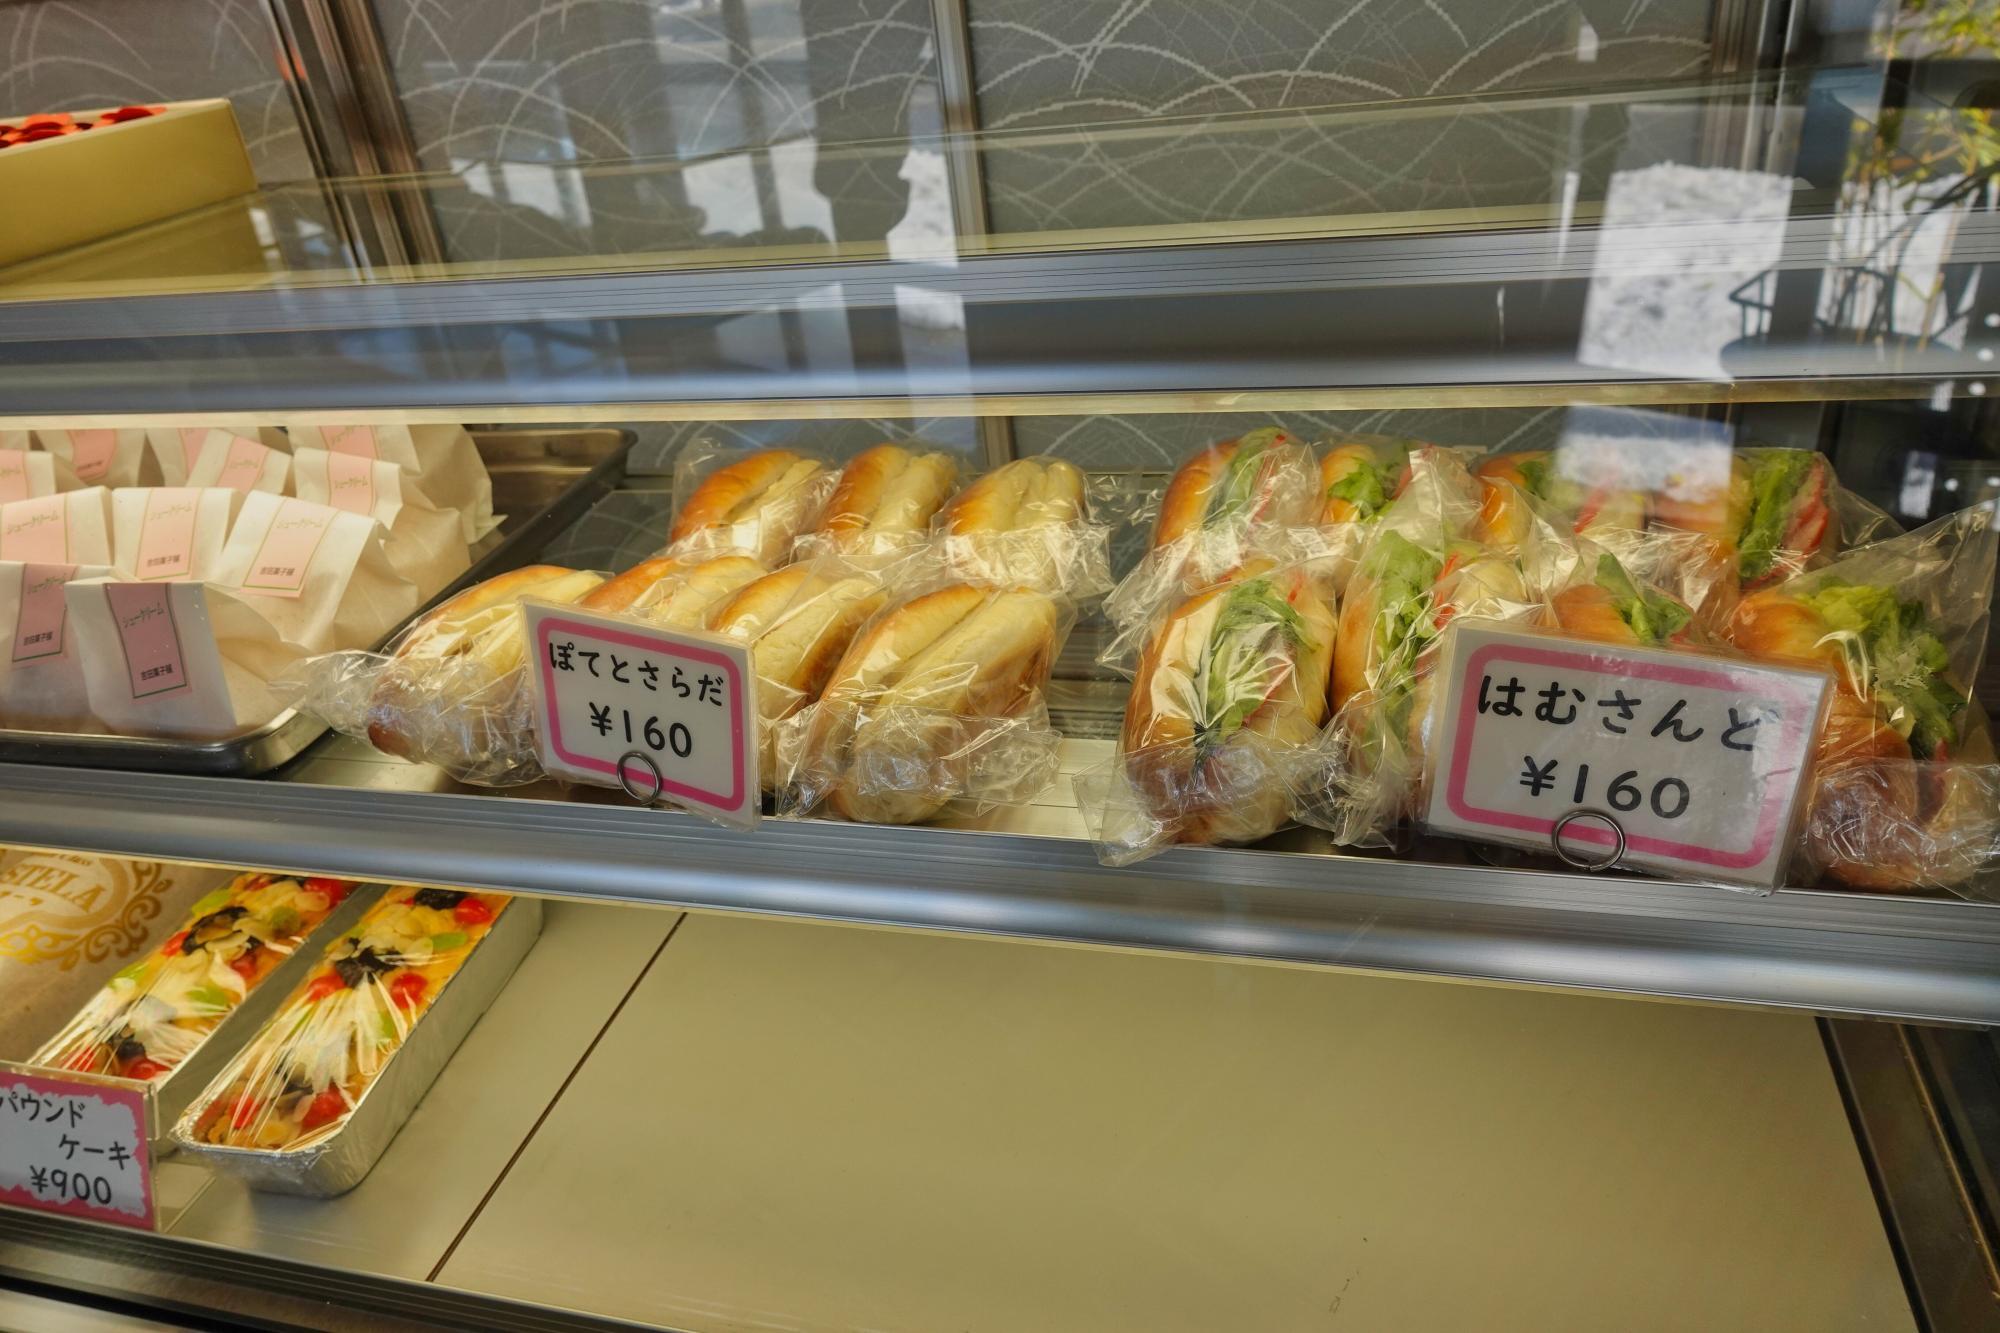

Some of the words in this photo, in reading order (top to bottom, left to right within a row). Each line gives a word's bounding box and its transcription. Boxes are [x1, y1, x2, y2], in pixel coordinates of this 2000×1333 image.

[549, 642, 724, 706] ぽてとさらだ
[588, 701, 693, 758] ¥160
[1519, 755, 1690, 819] ¥160
[59, 1134, 130, 1170] ケーキ
[29, 1164, 112, 1205] ¥900
